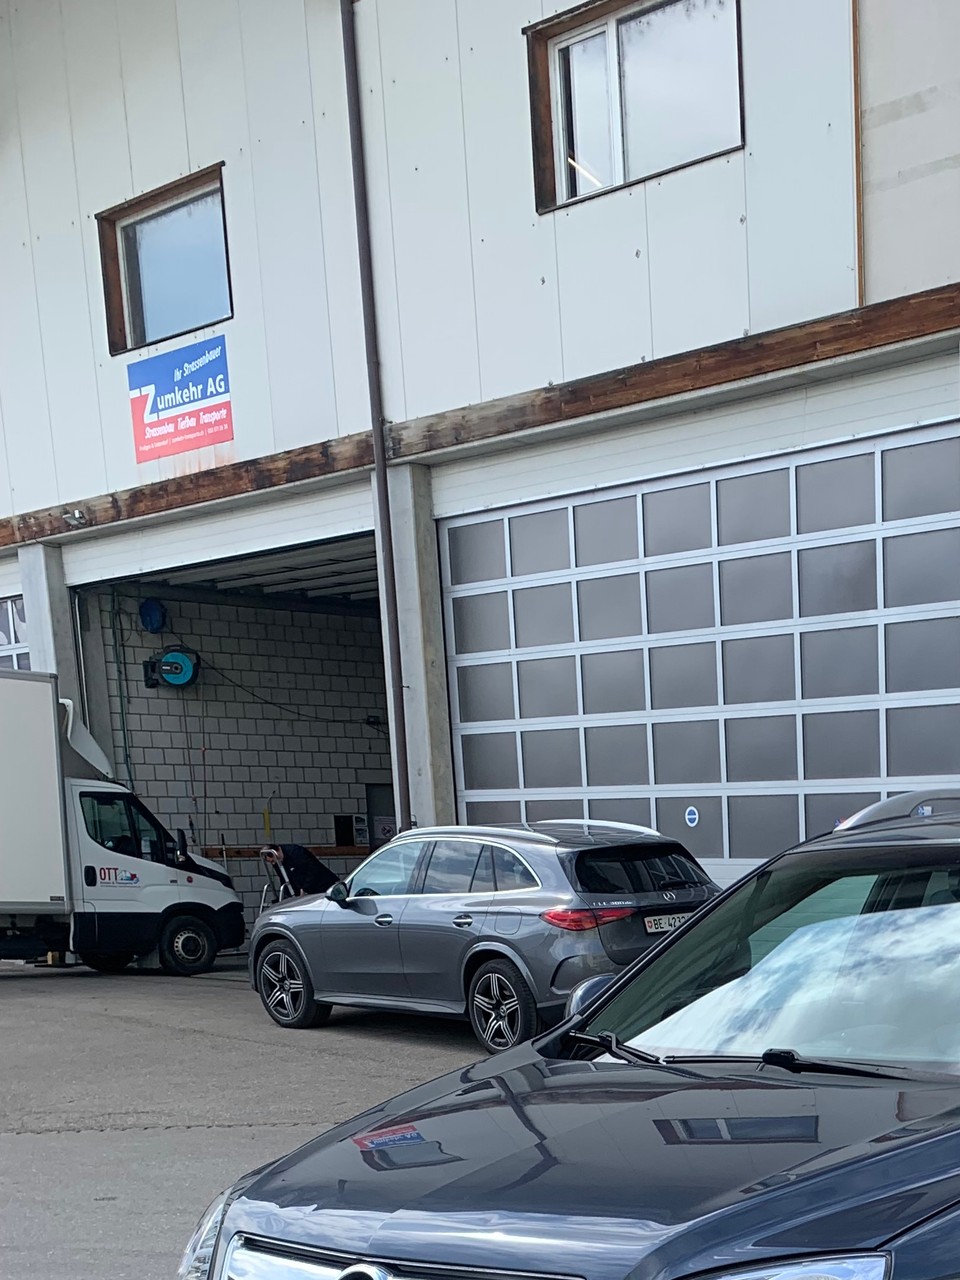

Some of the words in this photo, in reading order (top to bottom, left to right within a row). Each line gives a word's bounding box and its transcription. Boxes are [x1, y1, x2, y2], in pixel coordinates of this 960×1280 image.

[174, 368, 182, 382] Ihr
[183, 346, 221, 376] Strassenbauer
[141, 382, 202, 423] Zumkehr
[207, 375, 225, 396] AG
[145, 422, 174, 439] Strassenbau
[177, 416, 196, 430] Tiefbau
[199, 408, 227, 424] Transporte
[99, 867, 119, 881] OTT
[653, 918, 664, 930] BE
